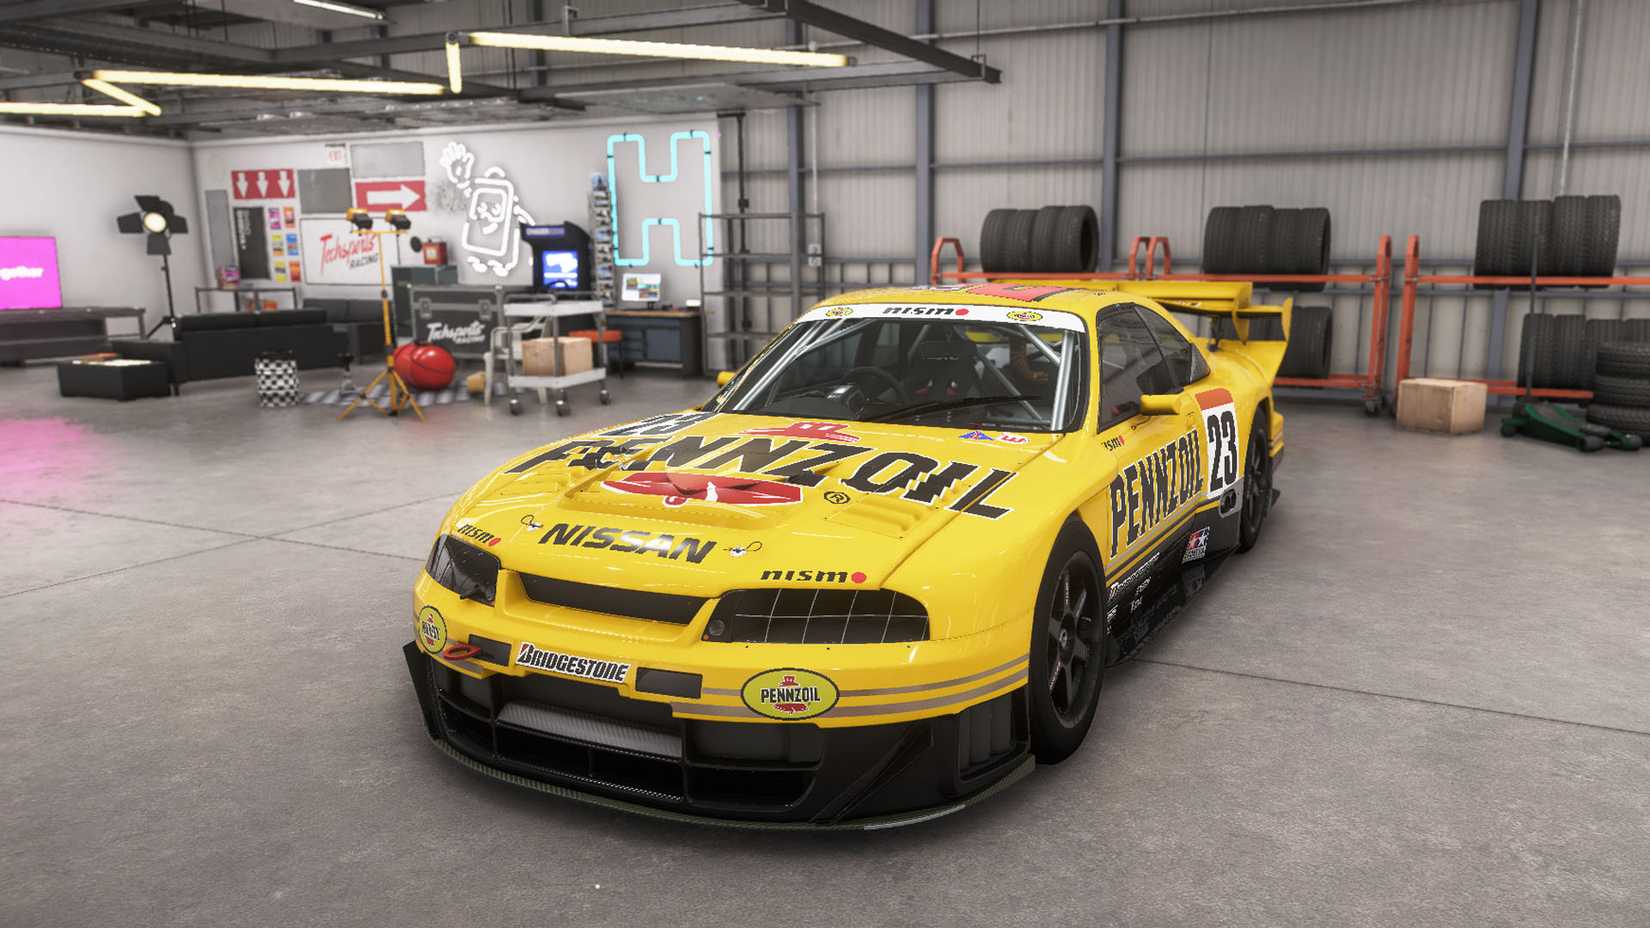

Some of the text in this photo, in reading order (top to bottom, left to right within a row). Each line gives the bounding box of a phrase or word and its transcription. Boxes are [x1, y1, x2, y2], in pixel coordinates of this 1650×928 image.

[1207, 410, 1238, 492] 23
[1109, 430, 1204, 558] PENNZOIL
[538, 522, 717, 564] NISSAN
[516, 642, 630, 684] BRIDGESTONE
[760, 687, 821, 704] PENNZOIL
